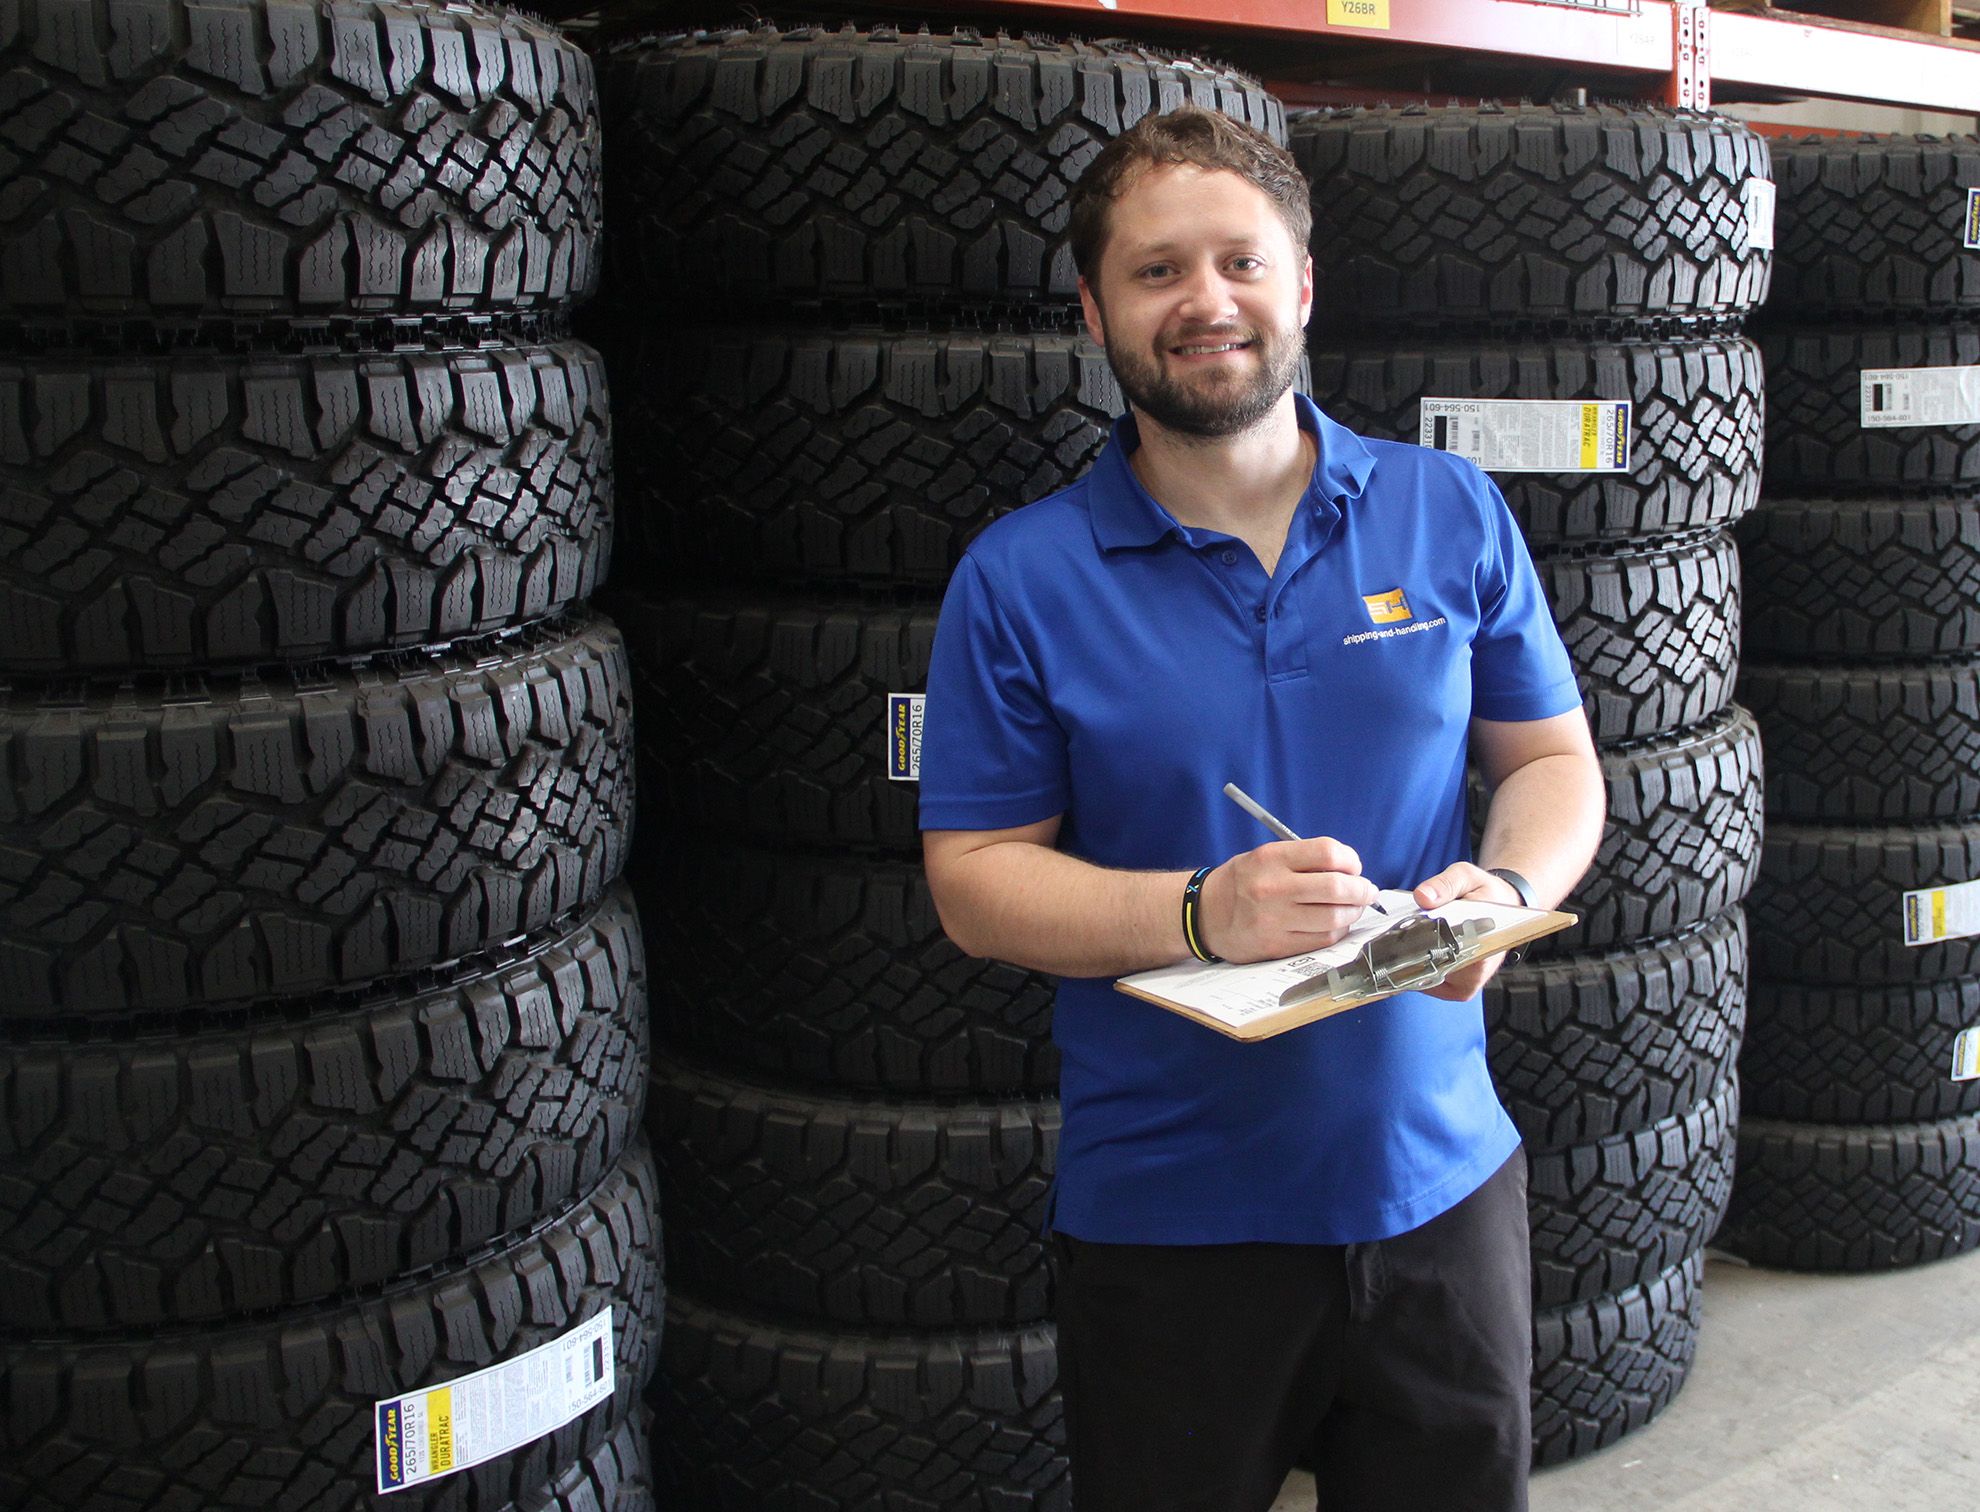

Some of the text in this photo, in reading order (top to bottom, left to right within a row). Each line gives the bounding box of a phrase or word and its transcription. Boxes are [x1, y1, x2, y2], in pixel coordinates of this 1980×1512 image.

[1582, 407, 1591, 448] DURATRAC
[1605, 409, 1614, 464] 265/70R16
[1616, 408, 1626, 464] GOODYEAR
[1343, 616, 1447, 646] shipping-and-handling.com
[895, 703, 906, 771] GOODYEAR
[911, 704, 923, 770] 265/70R16
[385, 1408, 399, 1481] GOODYEAR
[403, 1403, 417, 1474] 265/70R16
[429, 1432, 439, 1471] WRANGLER
[438, 1414, 451, 1467] DURATRAC
